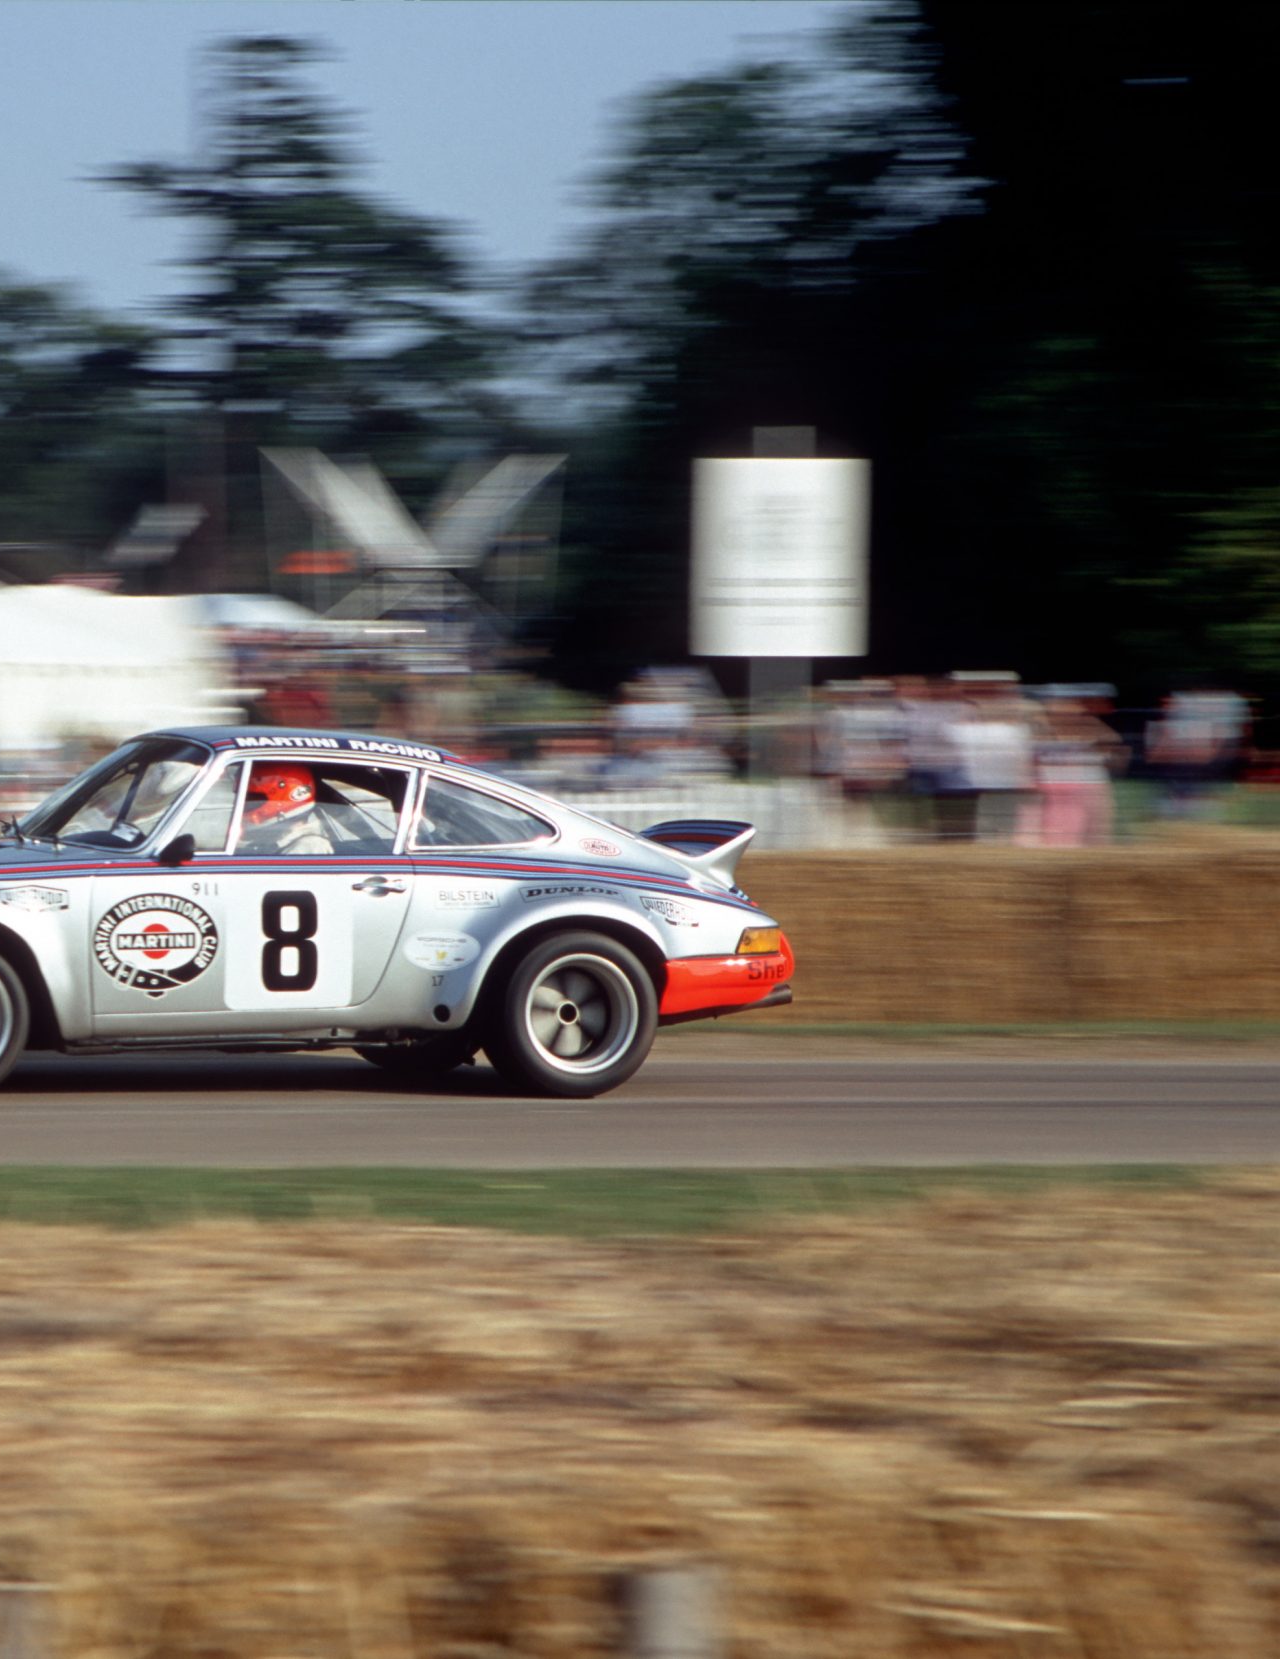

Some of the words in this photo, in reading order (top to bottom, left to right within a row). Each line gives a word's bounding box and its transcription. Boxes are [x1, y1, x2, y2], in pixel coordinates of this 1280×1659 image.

[235, 737, 339, 749] MARTINI
[348, 739, 442, 762] RACING
[192, 882, 218, 896] 911
[439, 890, 495, 901] BILSTEIN
[526, 886, 619, 898] DUNLOP
[95, 914, 120, 971] MARTINI
[114, 895, 213, 934] INTERNATIONAL
[193, 935, 217, 969] CLUB
[119, 934, 194, 948] MARTINI
[261, 890, 318, 992] 8
[748, 961, 788, 980] She
[431, 975, 444, 987] 17
